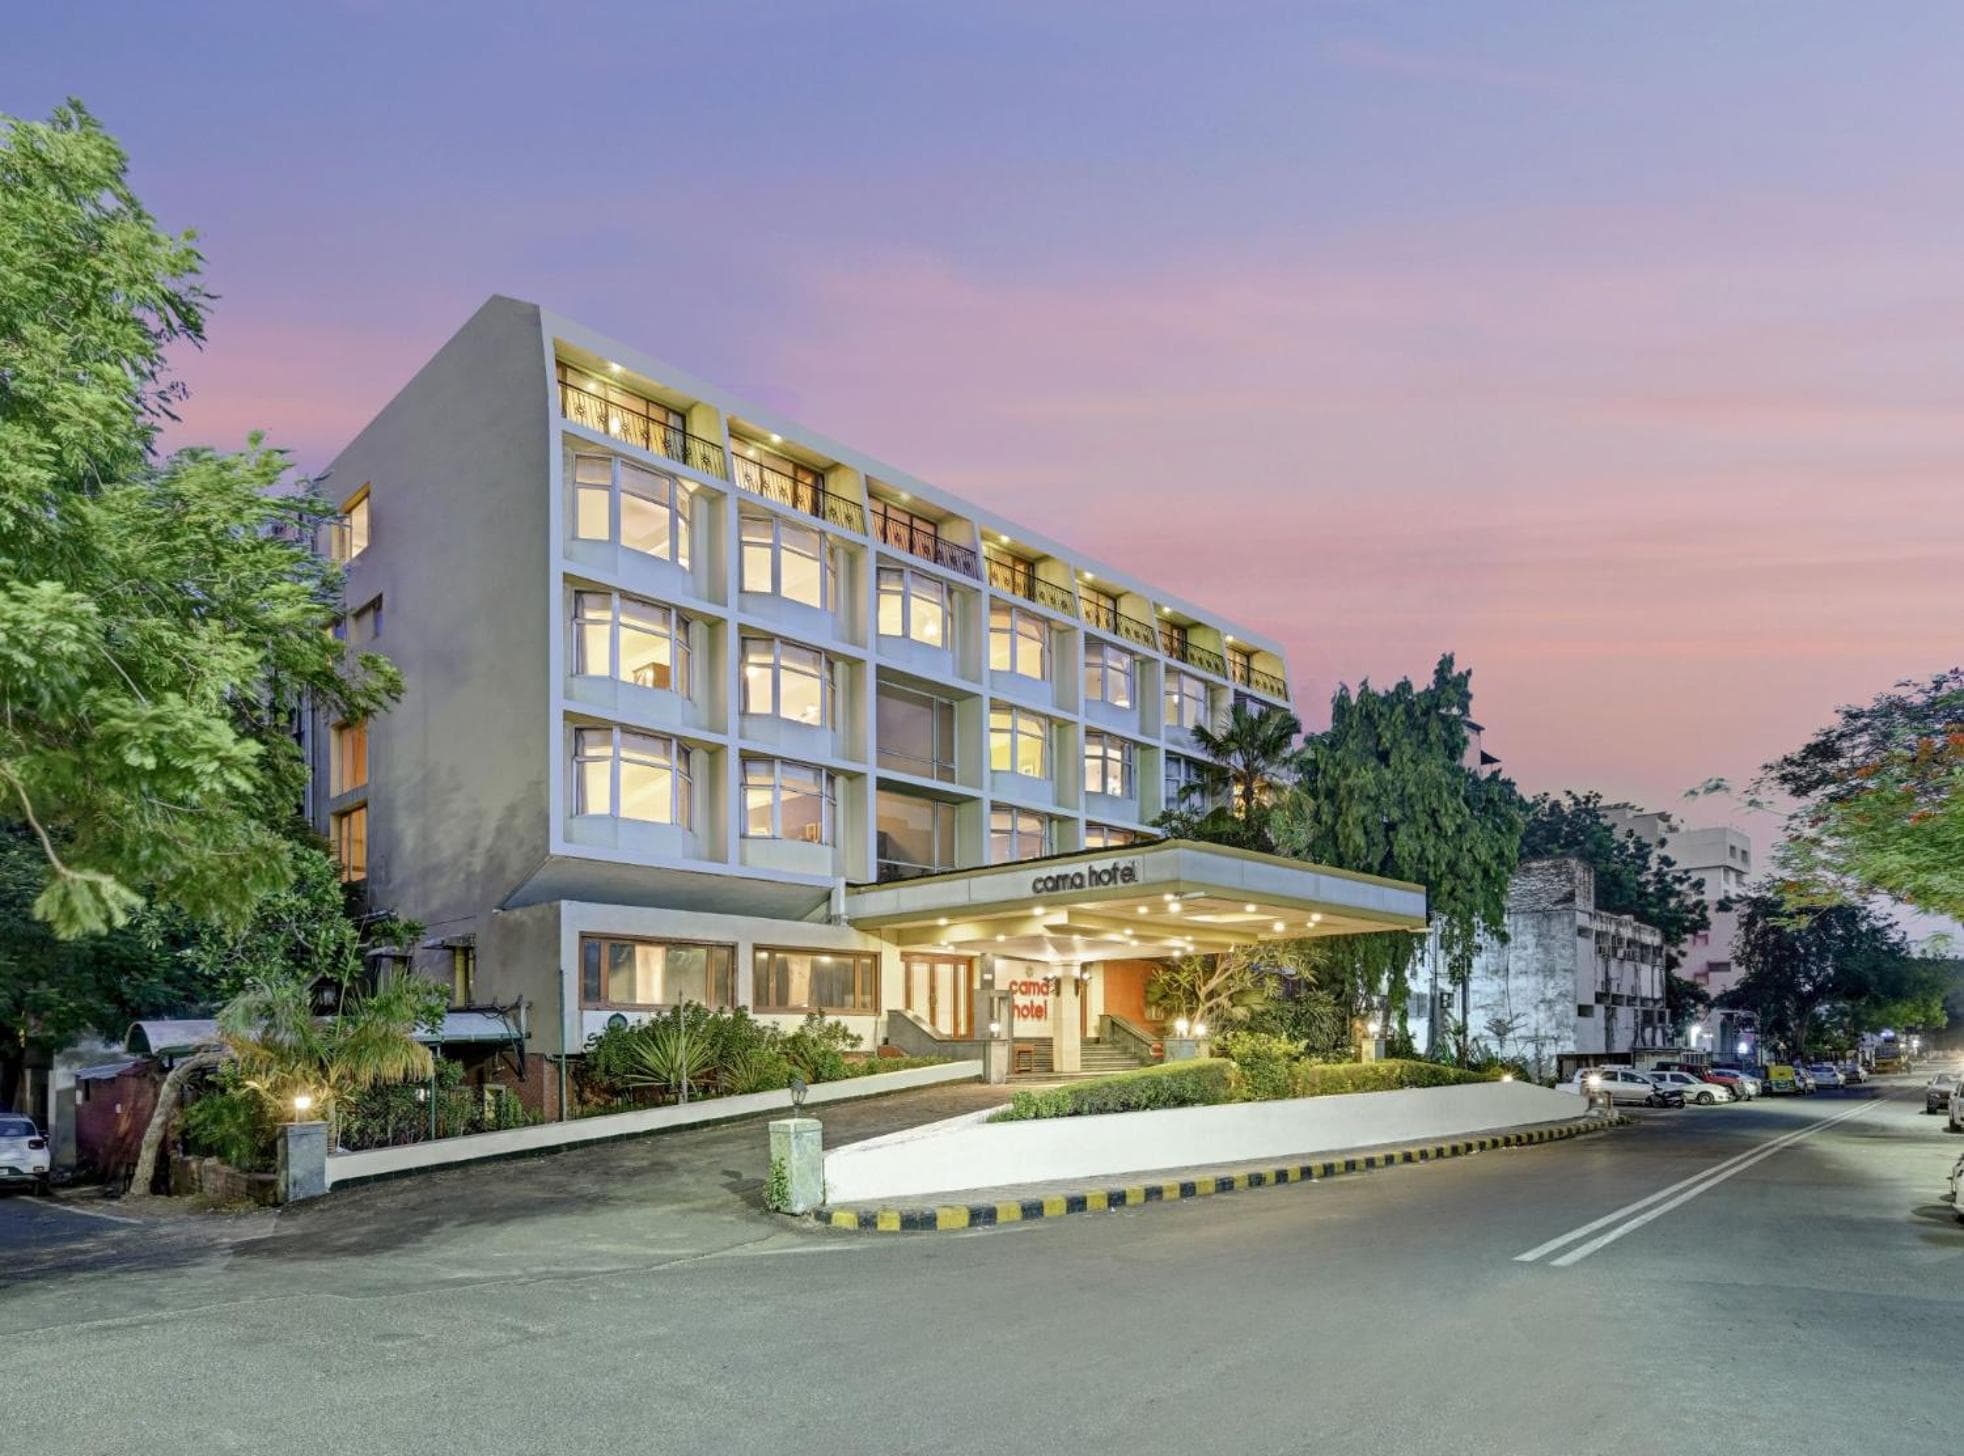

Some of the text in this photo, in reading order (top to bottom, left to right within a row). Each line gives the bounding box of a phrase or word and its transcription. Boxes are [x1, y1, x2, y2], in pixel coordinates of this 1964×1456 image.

[1032, 860, 1138, 893] cama hotel
[1009, 980, 1049, 996] cama
[1011, 999, 1048, 1020] hotel
